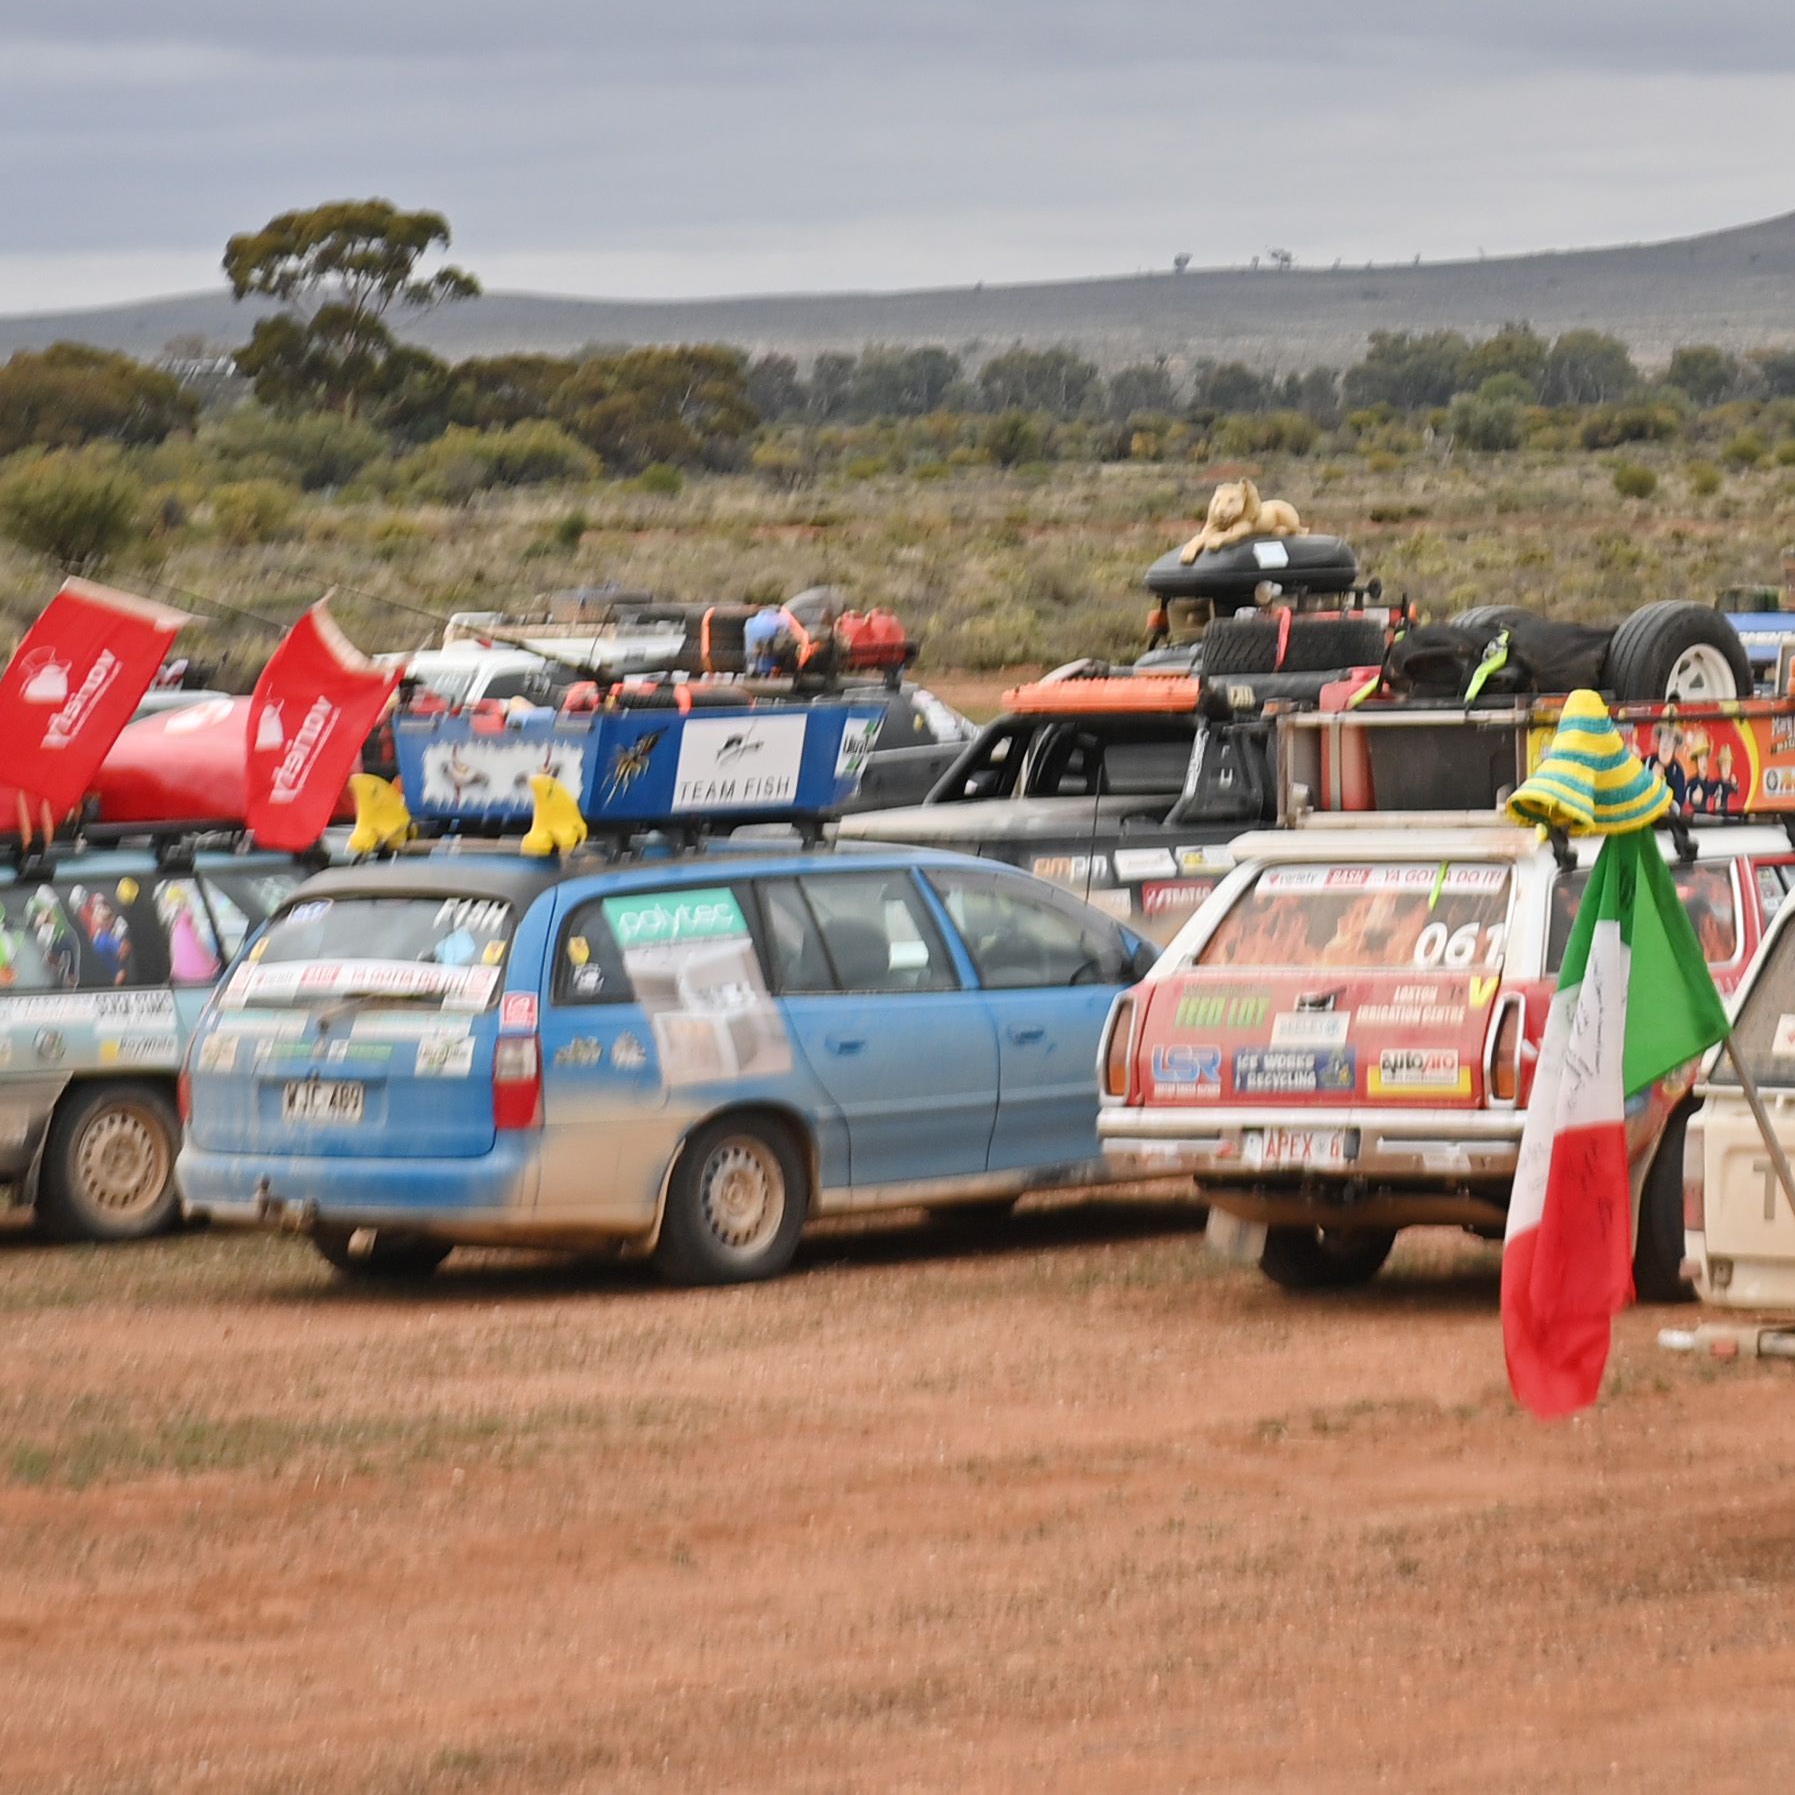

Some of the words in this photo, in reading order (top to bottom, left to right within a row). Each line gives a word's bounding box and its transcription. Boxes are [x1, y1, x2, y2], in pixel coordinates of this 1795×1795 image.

[680, 778, 737, 802] TEAM
[743, 775, 792, 799] FISH
[1404, 868, 1451, 882] GOTA
[1455, 869, 1481, 883] DO
[618, 902, 736, 938] polytec
[1413, 921, 1506, 970] 061
[1151, 1044, 1222, 1085] LSR
[1246, 1071, 1317, 1091] RECYCLING
[1265, 1127, 1314, 1159] APEX
